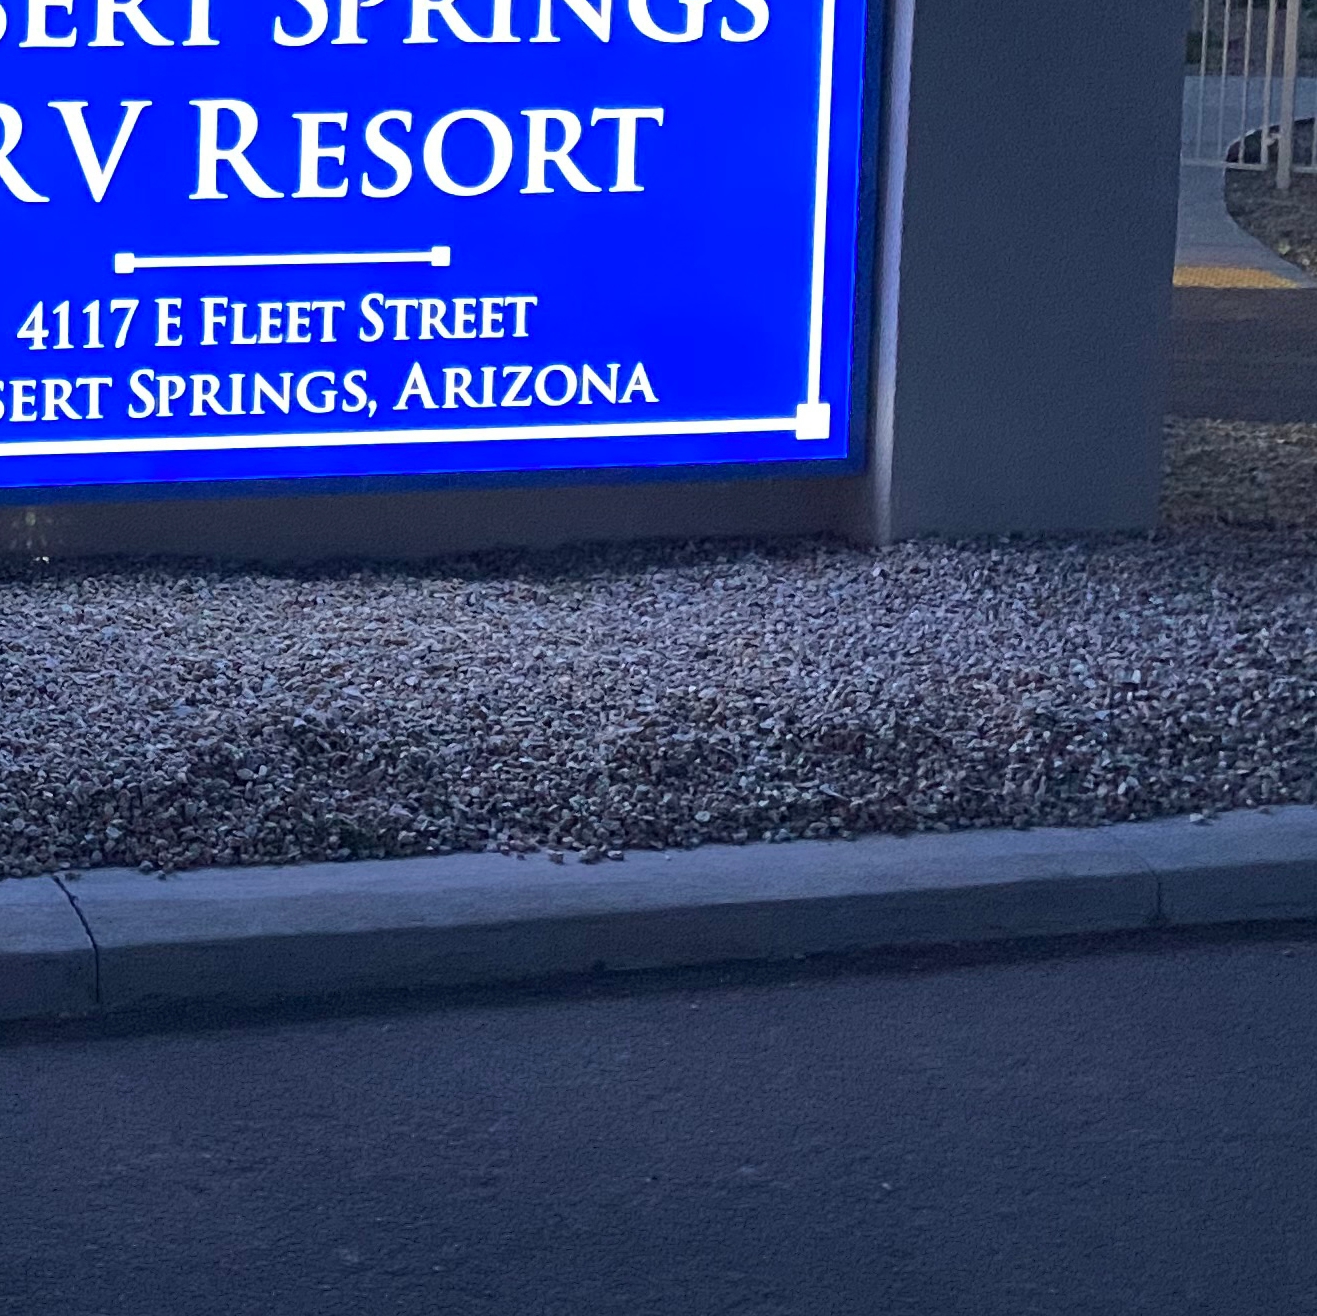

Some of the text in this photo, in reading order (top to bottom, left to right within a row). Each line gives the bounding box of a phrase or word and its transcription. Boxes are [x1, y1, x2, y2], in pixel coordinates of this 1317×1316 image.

[189, 99, 664, 199] RESORT
[17, 293, 537, 350] 4117 E FLEET STREET
[128, 369, 377, 418] SPRINGS,
[393, 362, 659, 410] ARIZONA
